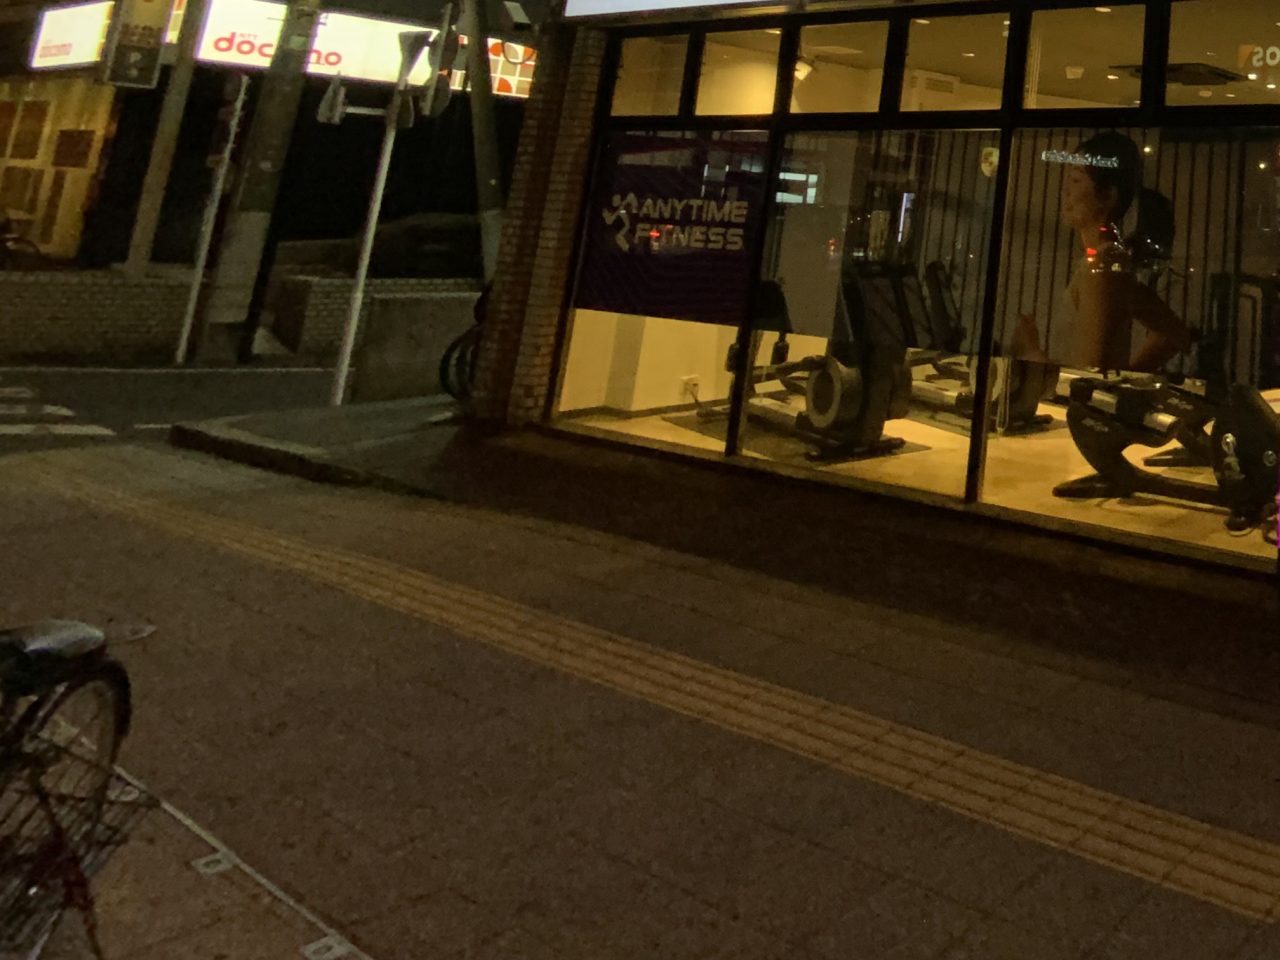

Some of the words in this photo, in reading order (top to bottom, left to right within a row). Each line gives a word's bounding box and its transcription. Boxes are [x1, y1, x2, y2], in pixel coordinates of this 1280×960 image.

[213, 31, 342, 66] doco
[639, 197, 749, 224] ANYTIME
[633, 223, 744, 251] FITNESS
